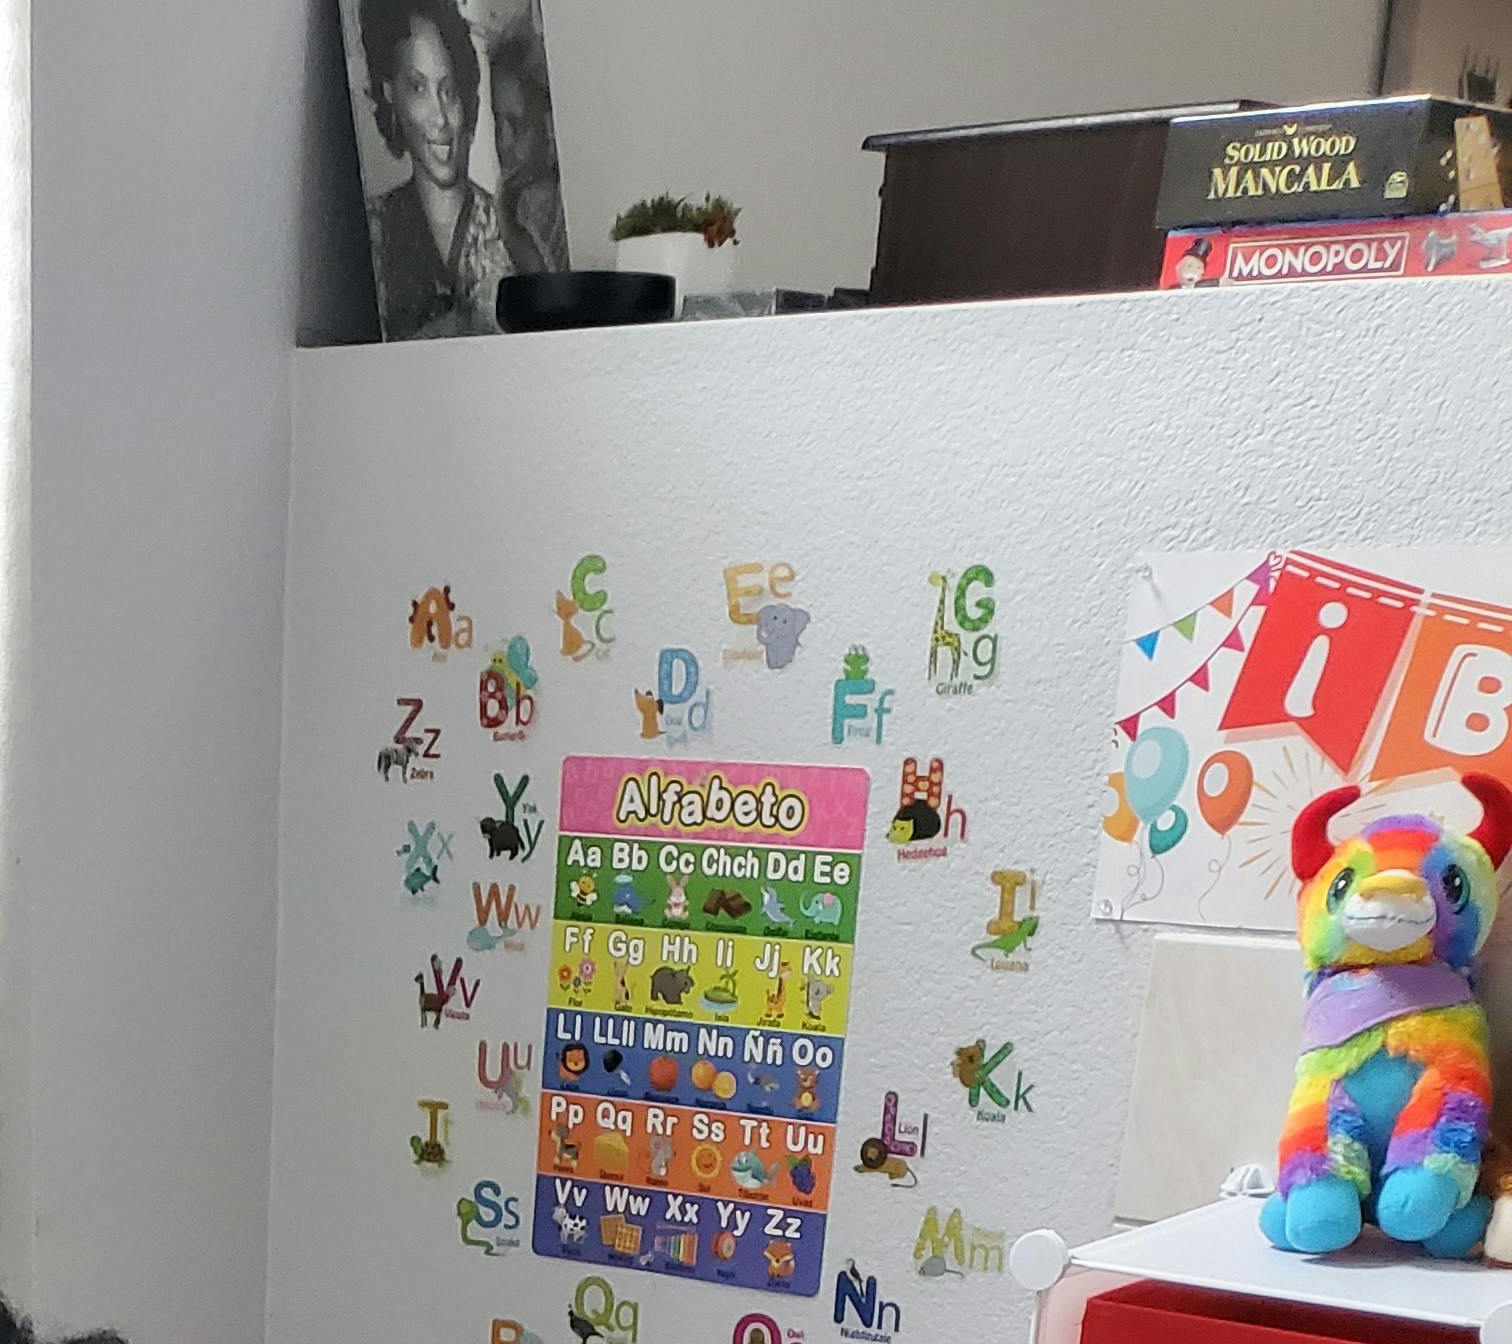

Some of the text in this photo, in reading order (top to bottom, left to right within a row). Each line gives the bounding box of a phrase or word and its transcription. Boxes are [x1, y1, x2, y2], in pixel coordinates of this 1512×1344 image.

[1224, 134, 1357, 164] SOLID WOOD
[1207, 161, 1361, 199] MANCALA
[1233, 240, 1401, 277] MONOPOLY
[617, 772, 805, 831] Alfabeto
[567, 839, 850, 884] Aa Bb Cc Chch Dd Ee
[564, 928, 840, 978] Ff Gg Hh Ii Jj Kk
[557, 1013, 832, 1068] Ll LLll Mm Nn Ññ Oo
[551, 1096, 824, 1154] Pp Qq Rr Ss Tt Uu
[555, 1178, 802, 1238] Vv Ww Xx Yy Zz
